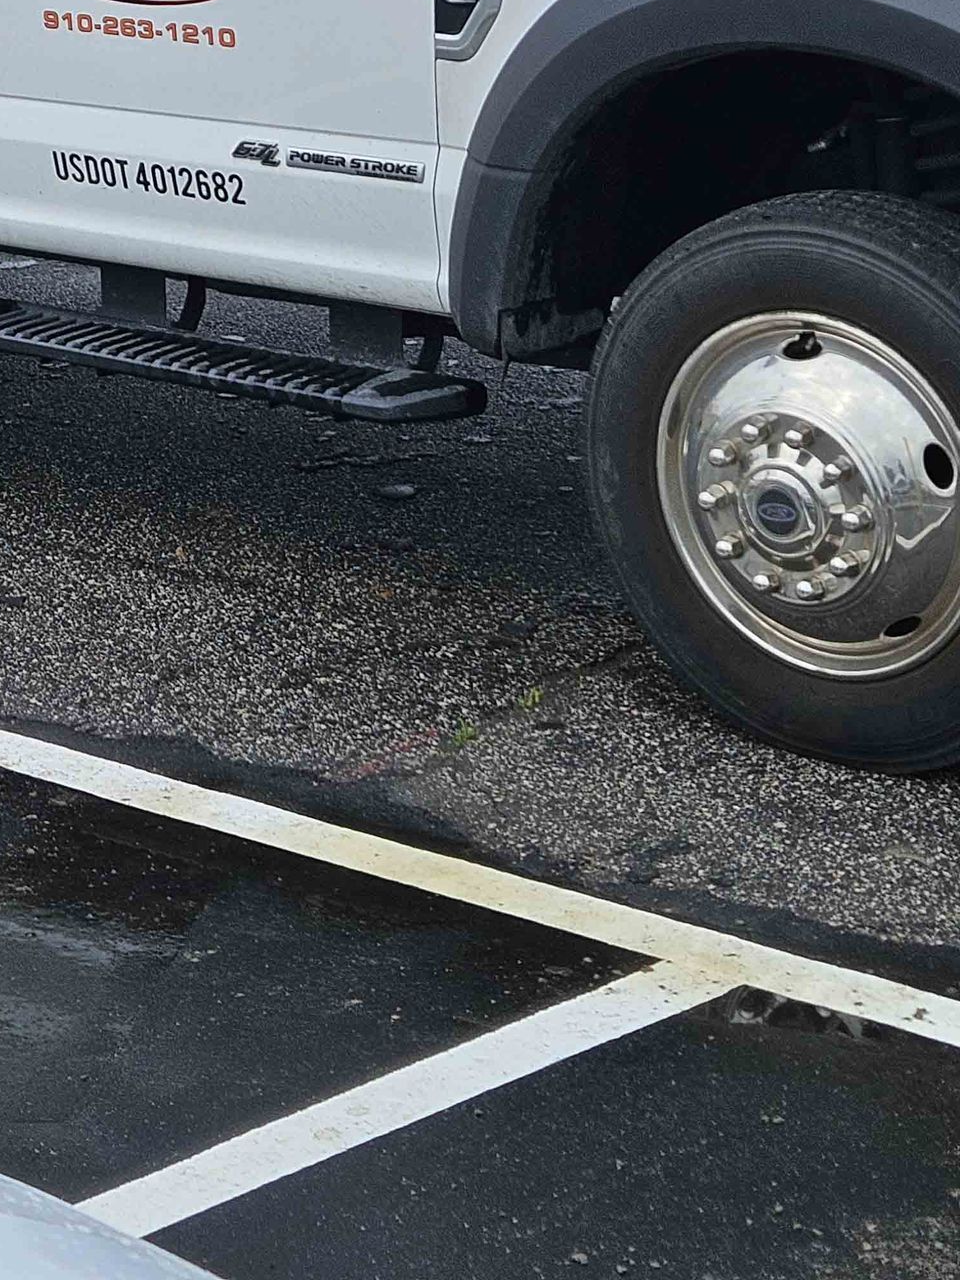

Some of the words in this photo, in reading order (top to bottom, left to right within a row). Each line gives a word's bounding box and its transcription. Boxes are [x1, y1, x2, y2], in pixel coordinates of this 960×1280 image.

[43, 10, 237, 48] 910-263-1210
[52, 150, 129, 189] USDOT
[136, 161, 246, 206] 4012682
[289, 150, 346, 167] POWER
[350, 157, 418, 176] STROKE
